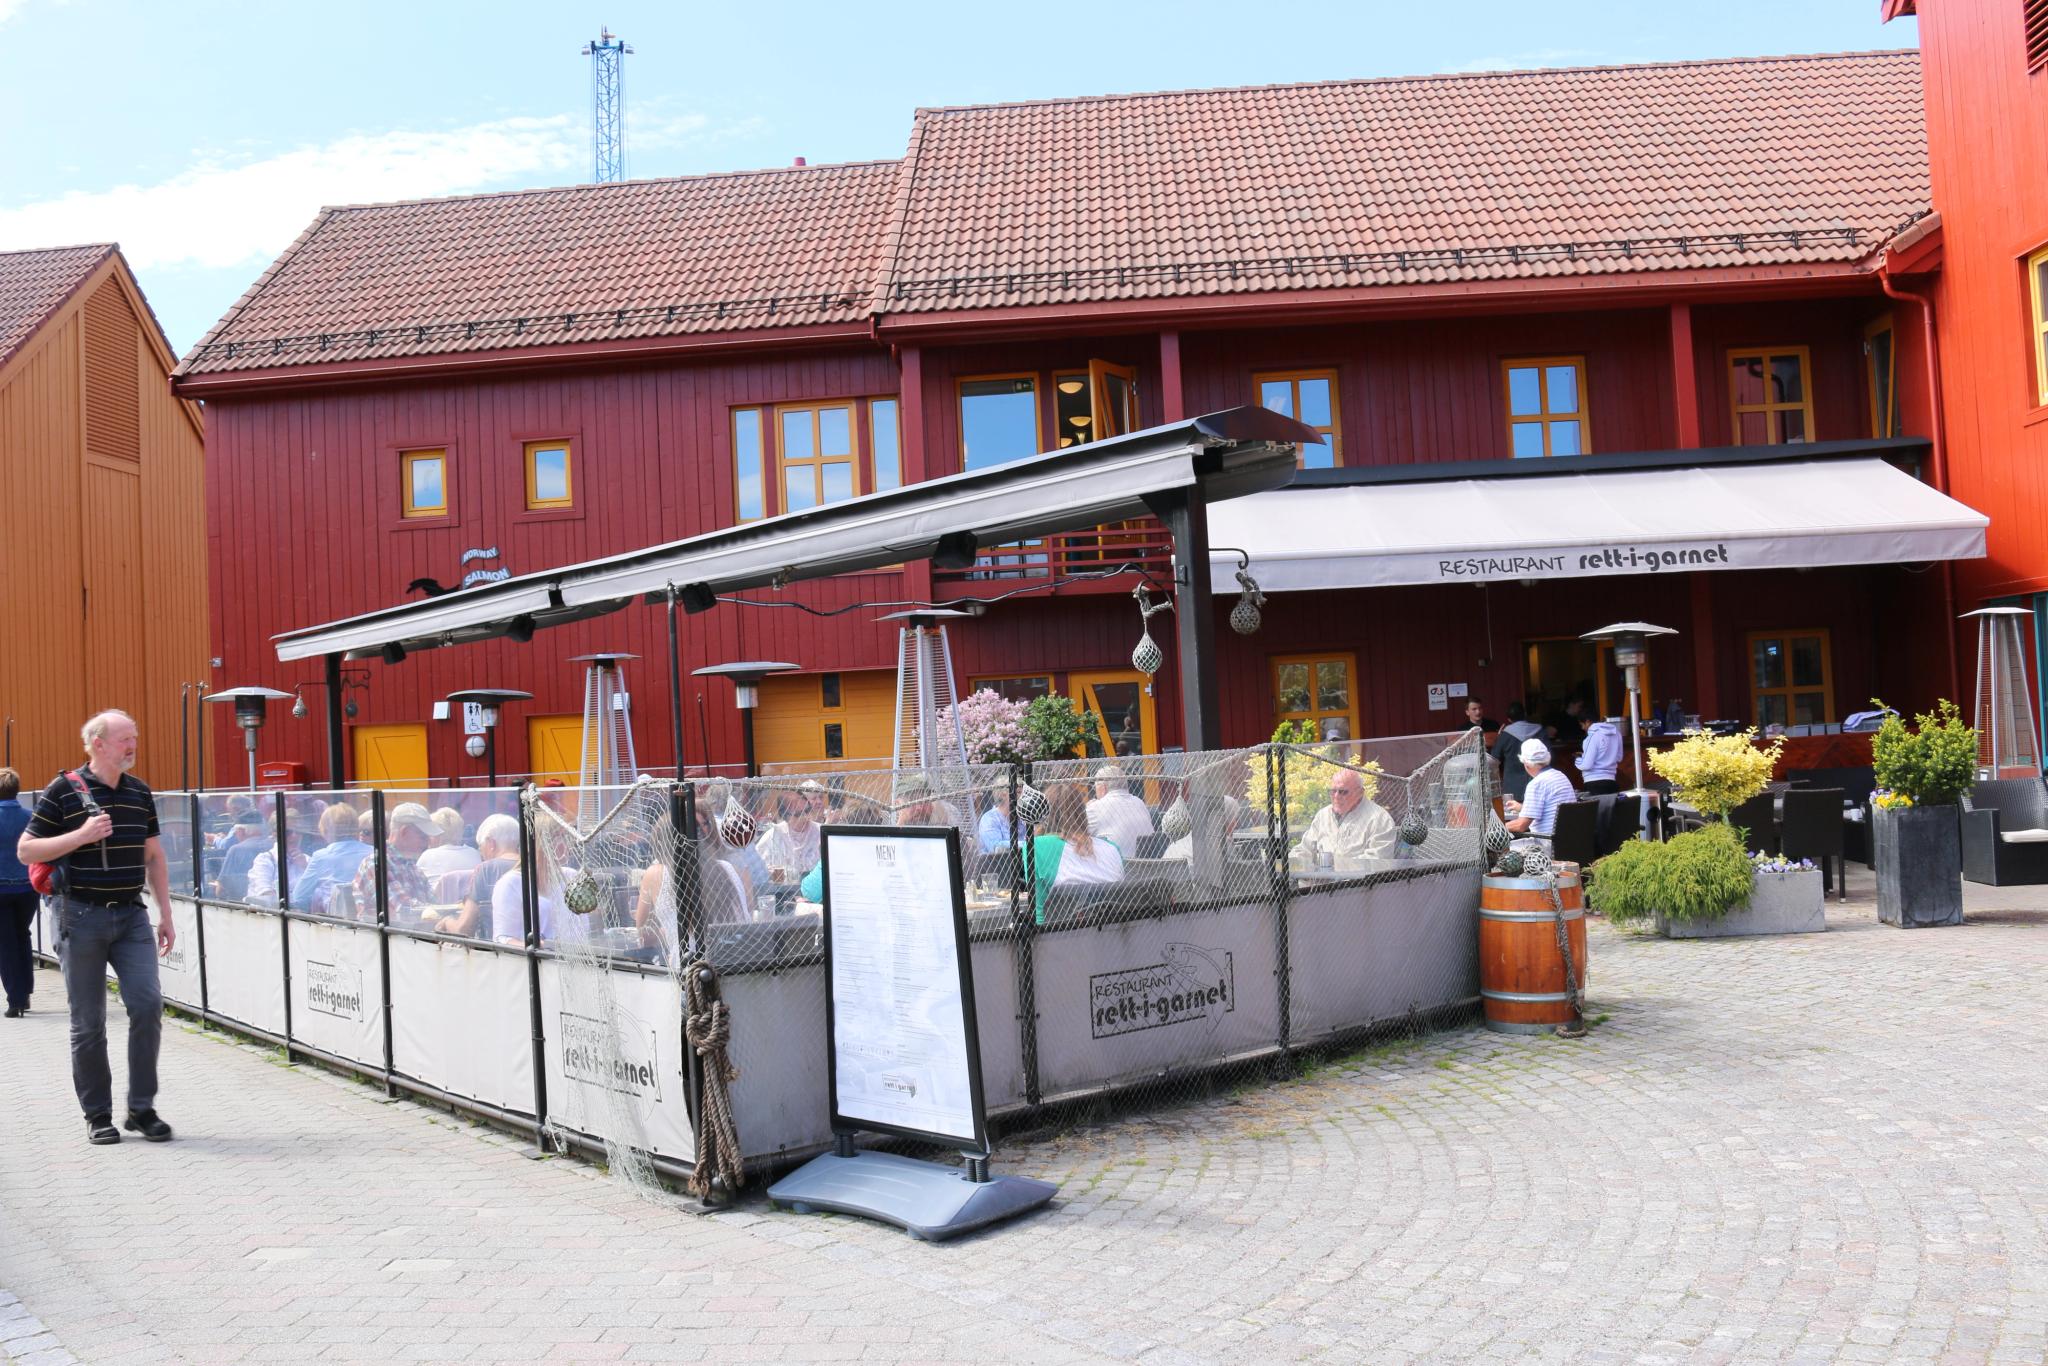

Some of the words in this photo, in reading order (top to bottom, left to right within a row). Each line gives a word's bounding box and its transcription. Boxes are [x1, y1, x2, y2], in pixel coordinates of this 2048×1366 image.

[463, 547, 498, 562] NORWAY
[1439, 556, 1565, 576] RESTAURANT
[1579, 543, 1728, 572] rett-i-garnet
[464, 567, 509, 586] SALMON
[875, 844, 896, 861] MENY
[308, 968, 337, 984] RESTAURANT
[1094, 974, 1173, 1000] RESTAURANT
[309, 983, 360, 1013] rett-i-garnet
[1095, 978, 1227, 1027] rett-i-garnet
